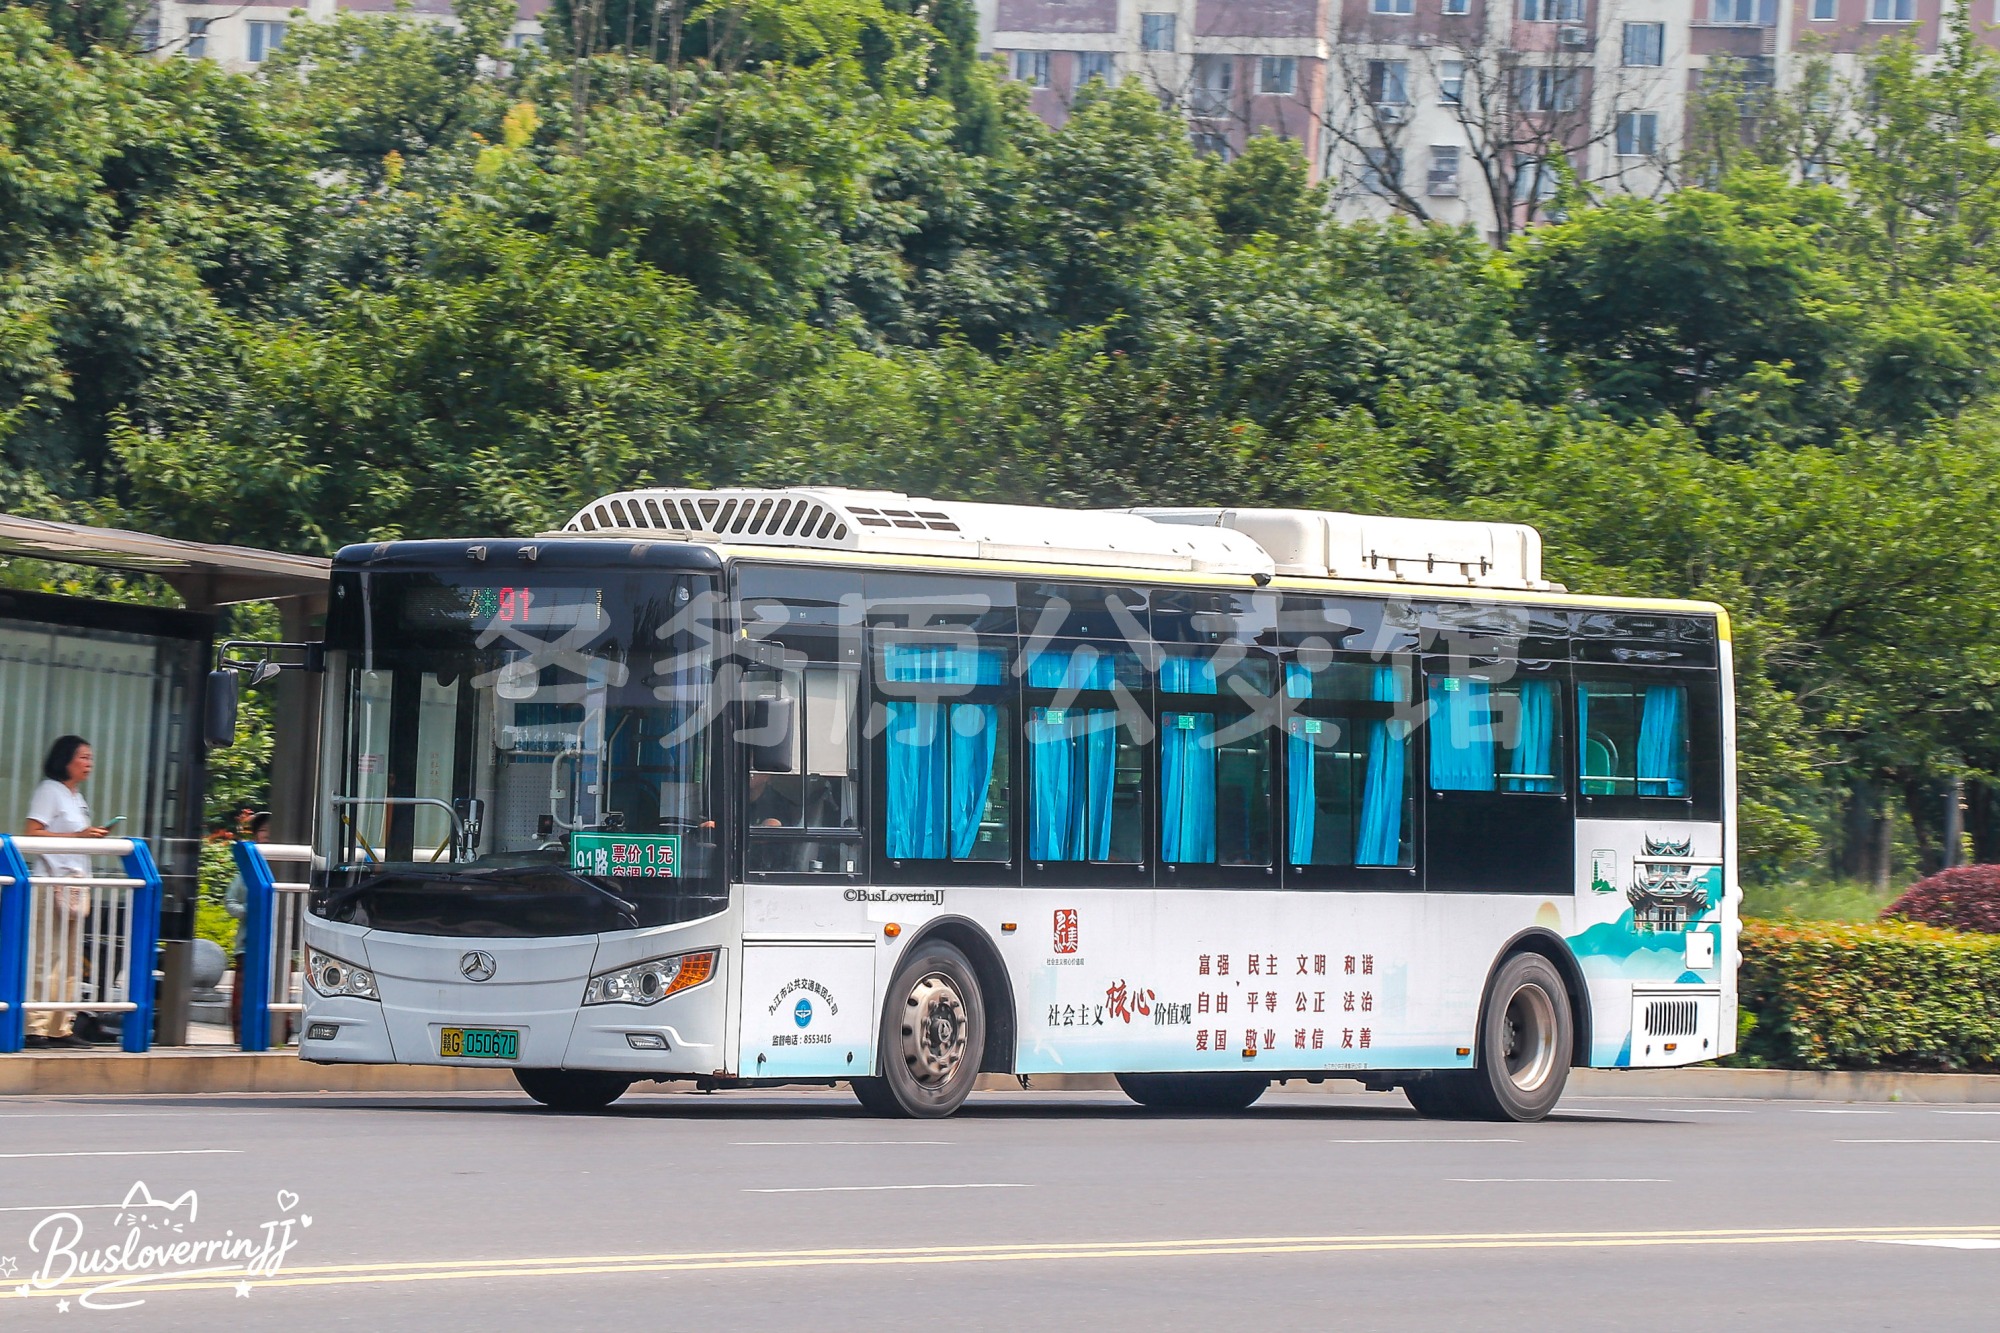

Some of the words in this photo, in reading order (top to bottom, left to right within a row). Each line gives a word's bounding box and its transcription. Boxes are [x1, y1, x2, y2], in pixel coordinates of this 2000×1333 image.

[499, 587, 530, 622] 91
[1198, 953, 1230, 976] 富强
[1247, 953, 1279, 976] 民主
[1296, 953, 1327, 976] 文明
[1344, 953, 1375, 976] 和谐
[768, 977, 839, 1016] 九江市公共交通集团公司
[1047, 978, 1193, 1028] 社会主义核心价值观
[1197, 991, 1229, 1014] 自由
[1246, 991, 1278, 1014] 平等
[1295, 991, 1326, 1013] 公正
[1343, 991, 1374, 1013] 法治
[1196, 1028, 1228, 1052] 爱国
[1245, 1028, 1277, 1051] 敬业
[1294, 1028, 1325, 1050] 诚信
[1341, 1028, 1373, 1050] 友善
